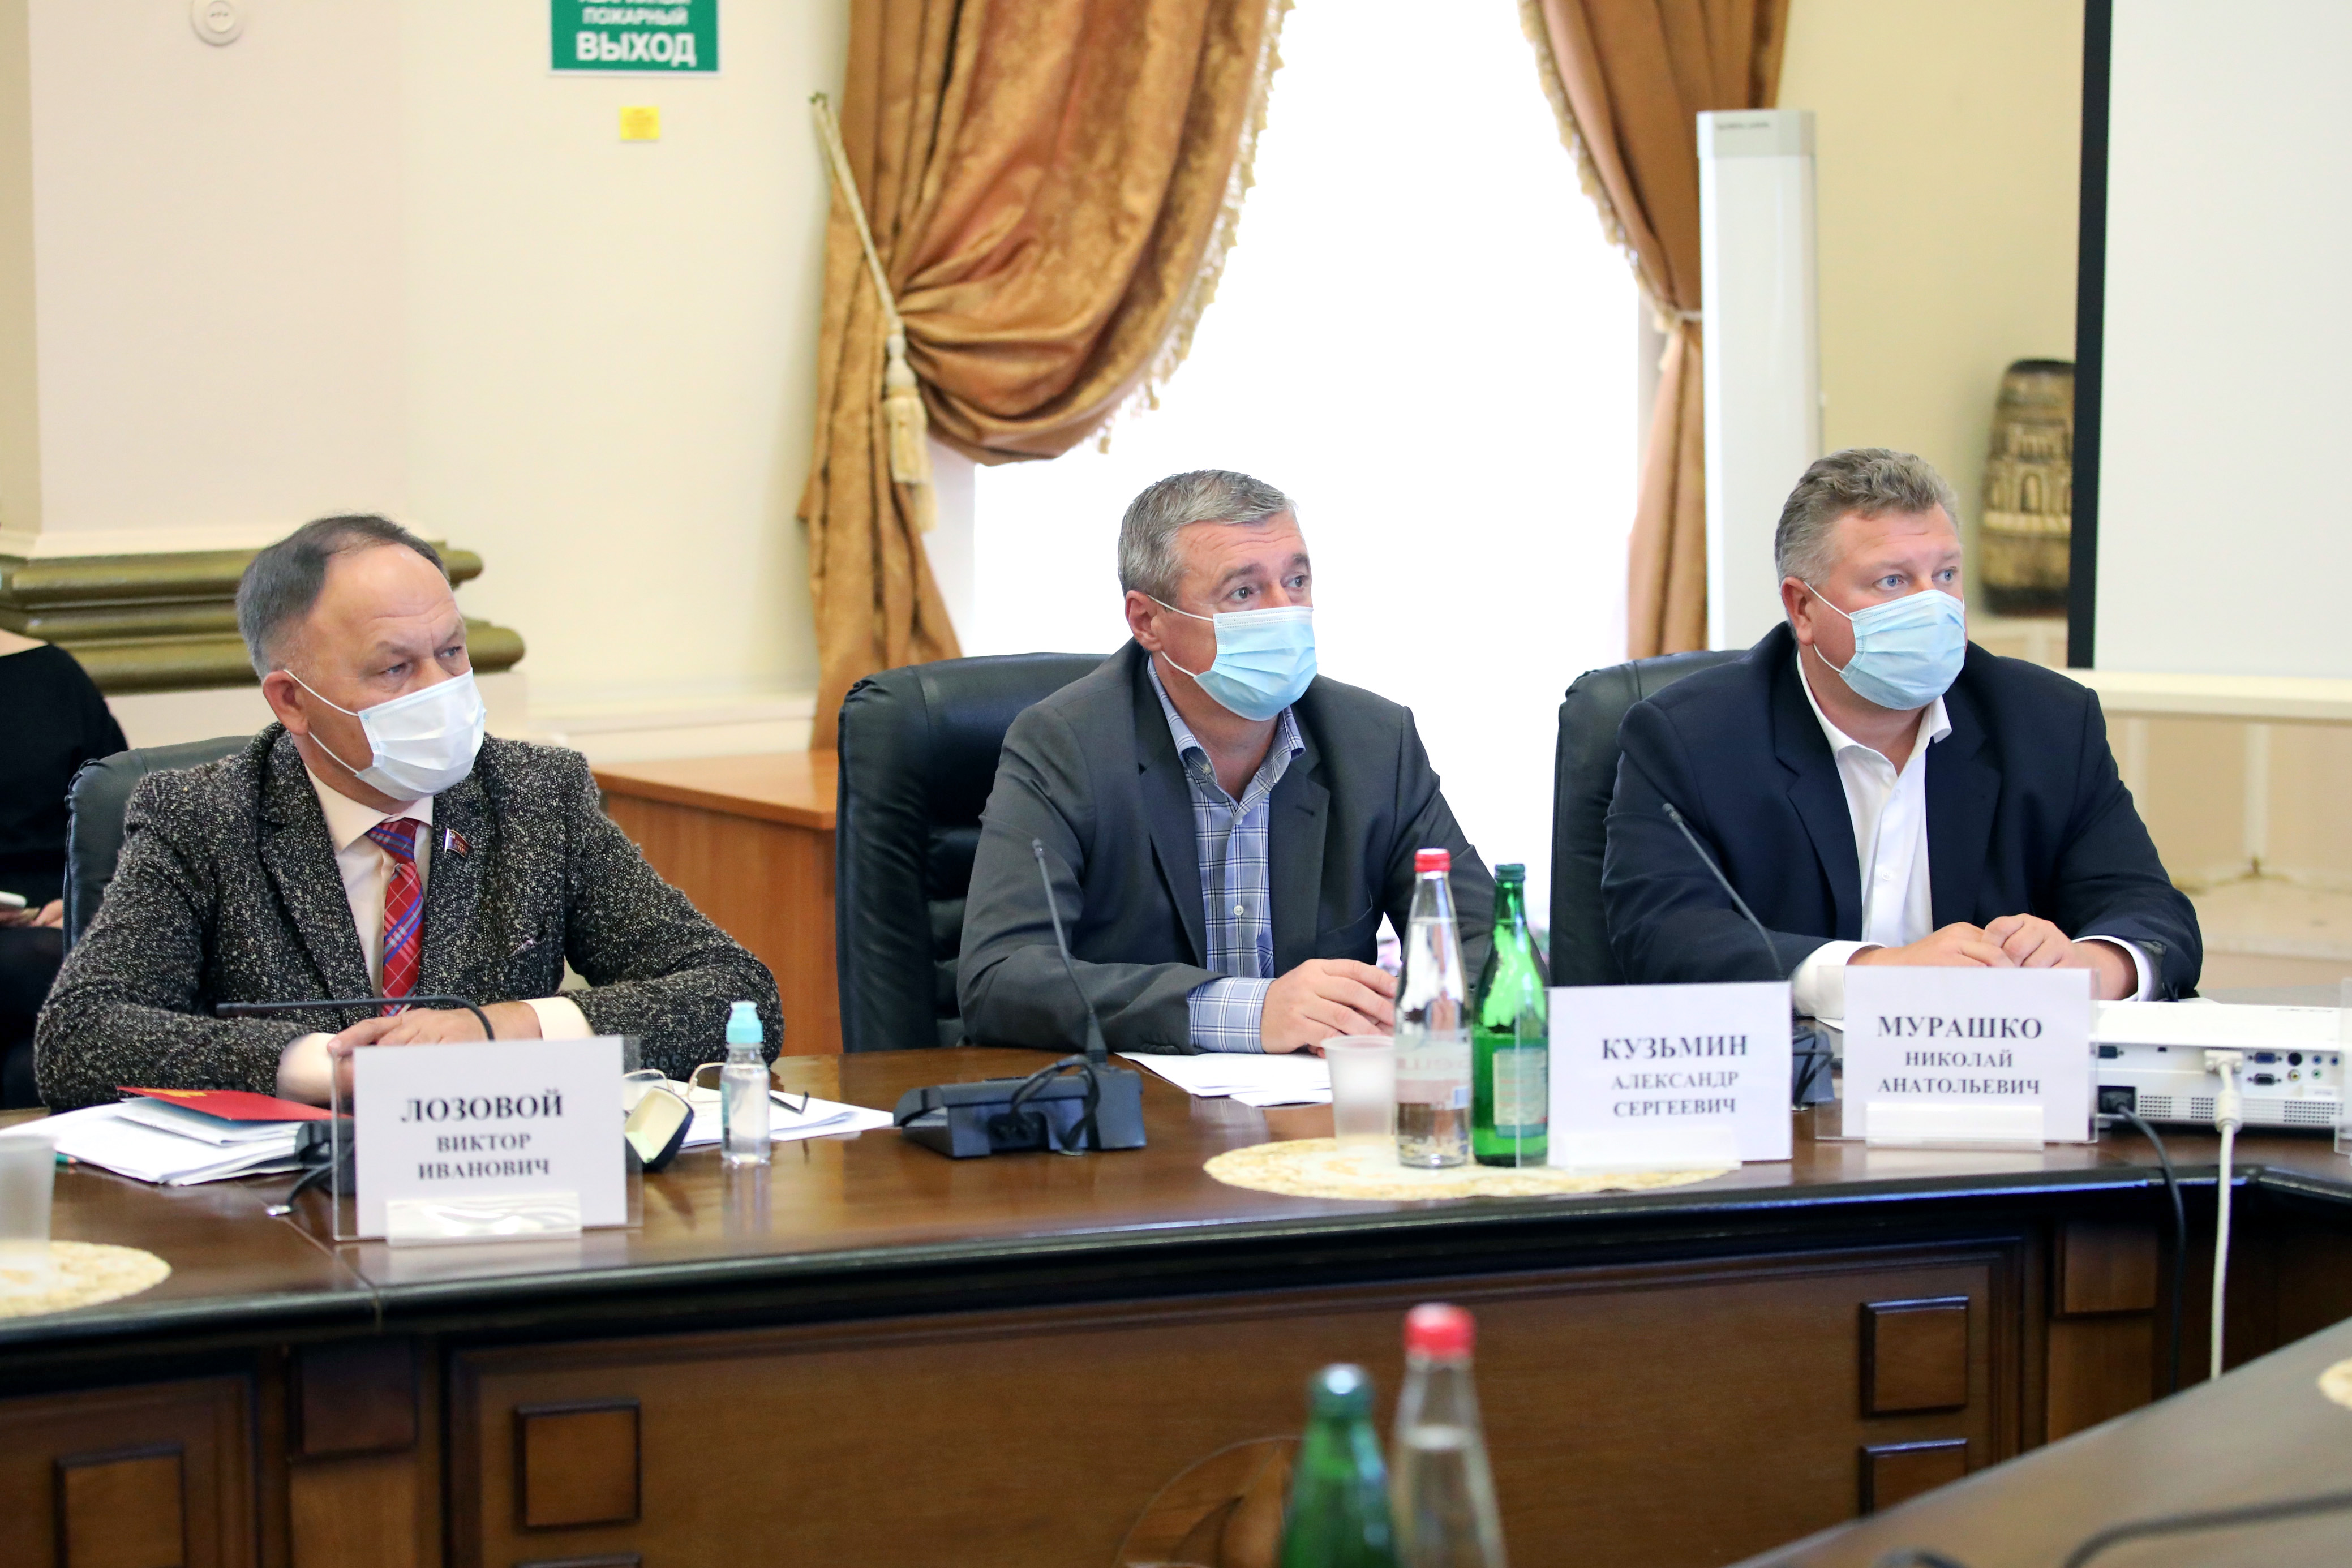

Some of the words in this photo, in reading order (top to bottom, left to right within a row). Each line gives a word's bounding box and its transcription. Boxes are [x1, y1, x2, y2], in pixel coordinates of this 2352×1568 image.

[576, 31, 697, 67] ВЫХОД
[1878, 1016, 2042, 1039] МУРАШКО
[1602, 1035, 1748, 1060] КУЗЬМИН
[1905, 1049, 2012, 1067] НИКОЛАЙ
[1612, 1071, 1739, 1090] АЛЕКСАНДР
[1877, 1077, 2040, 1095] АНАТОЛЬЕВИЧ
[401, 1088, 563, 1123] ЛОЗОВОЙ
[1613, 1098, 1736, 1117] СЕРГЕЕВИЧ
[437, 1133, 531, 1153] ВИКТОР
[418, 1159, 550, 1180] ИВАНОВИЧ
